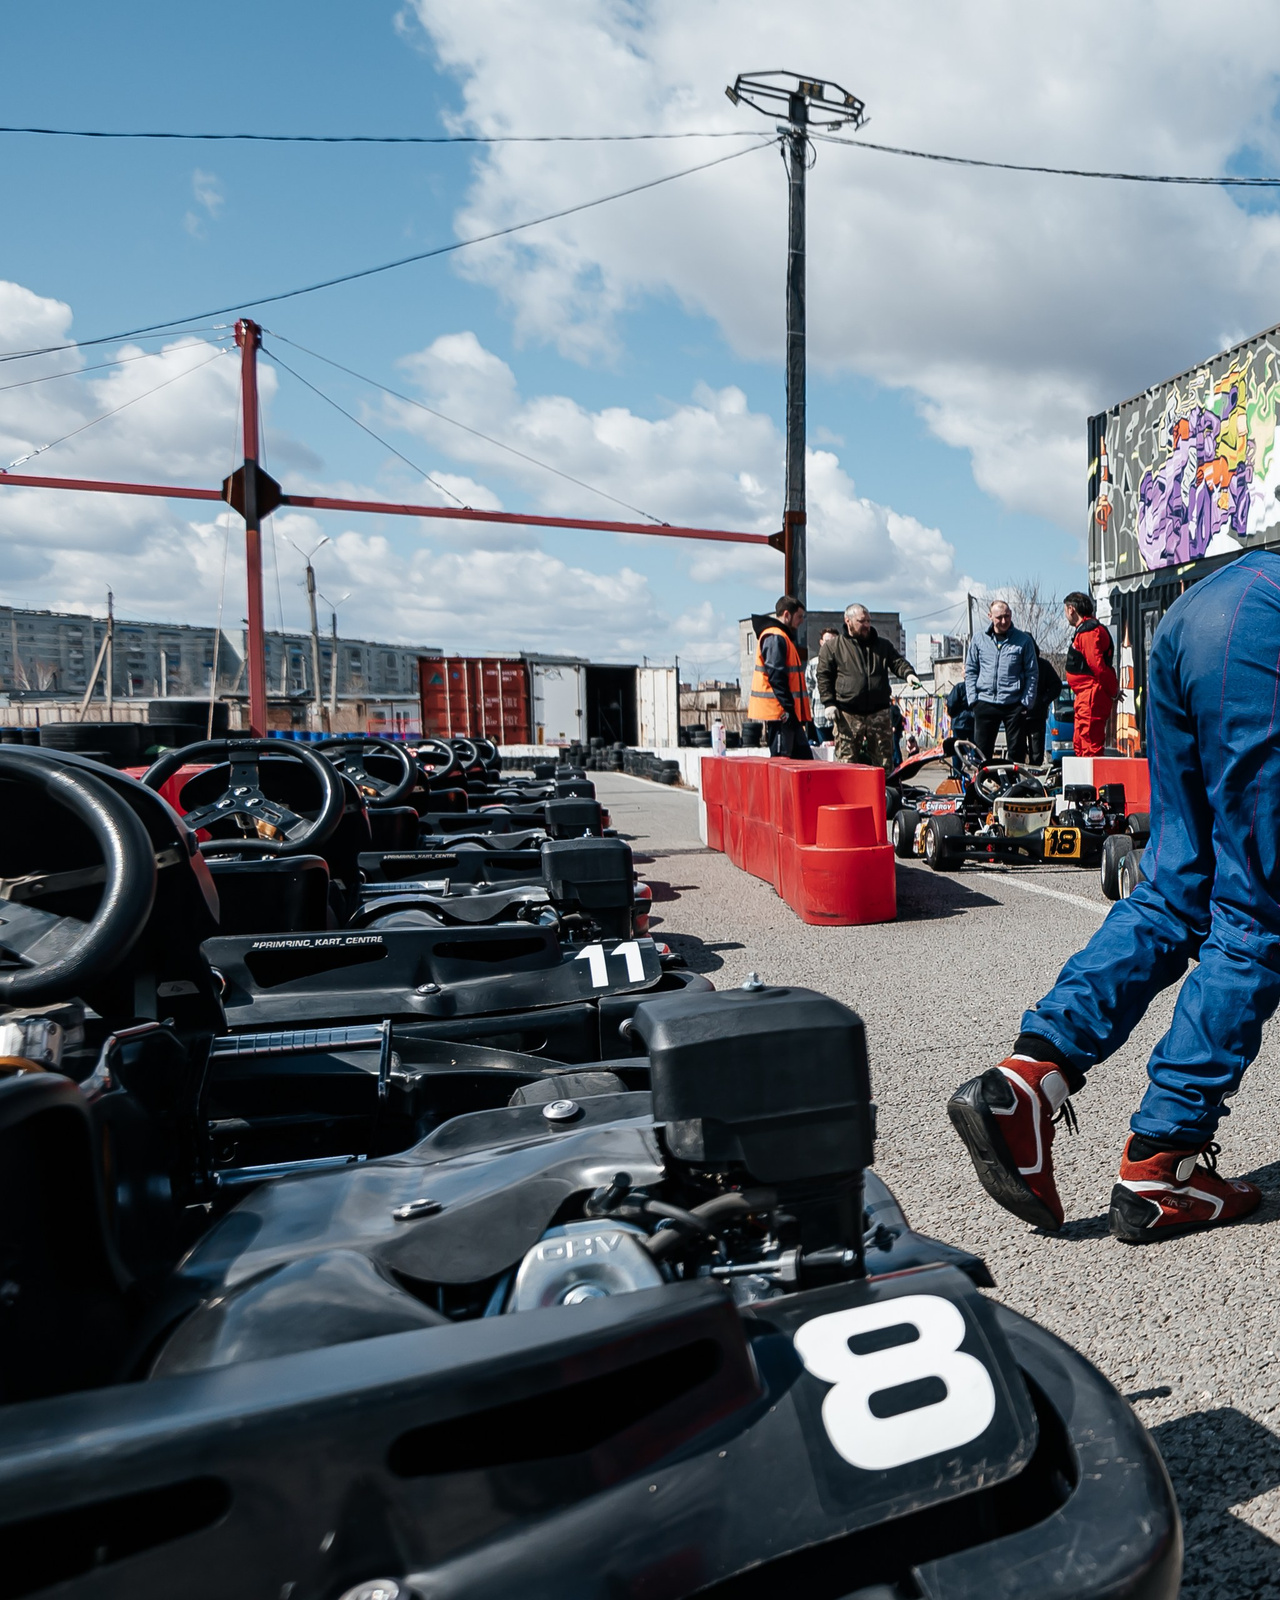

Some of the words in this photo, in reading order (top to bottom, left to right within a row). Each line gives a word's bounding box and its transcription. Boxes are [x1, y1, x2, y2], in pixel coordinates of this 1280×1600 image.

[1046, 829, 1078, 856] 18
[574, 941, 645, 988] 11
[1161, 1195, 1195, 1209] FIRST
[537, 1234, 624, 1261] OHV
[793, 1294, 996, 1471] 8
